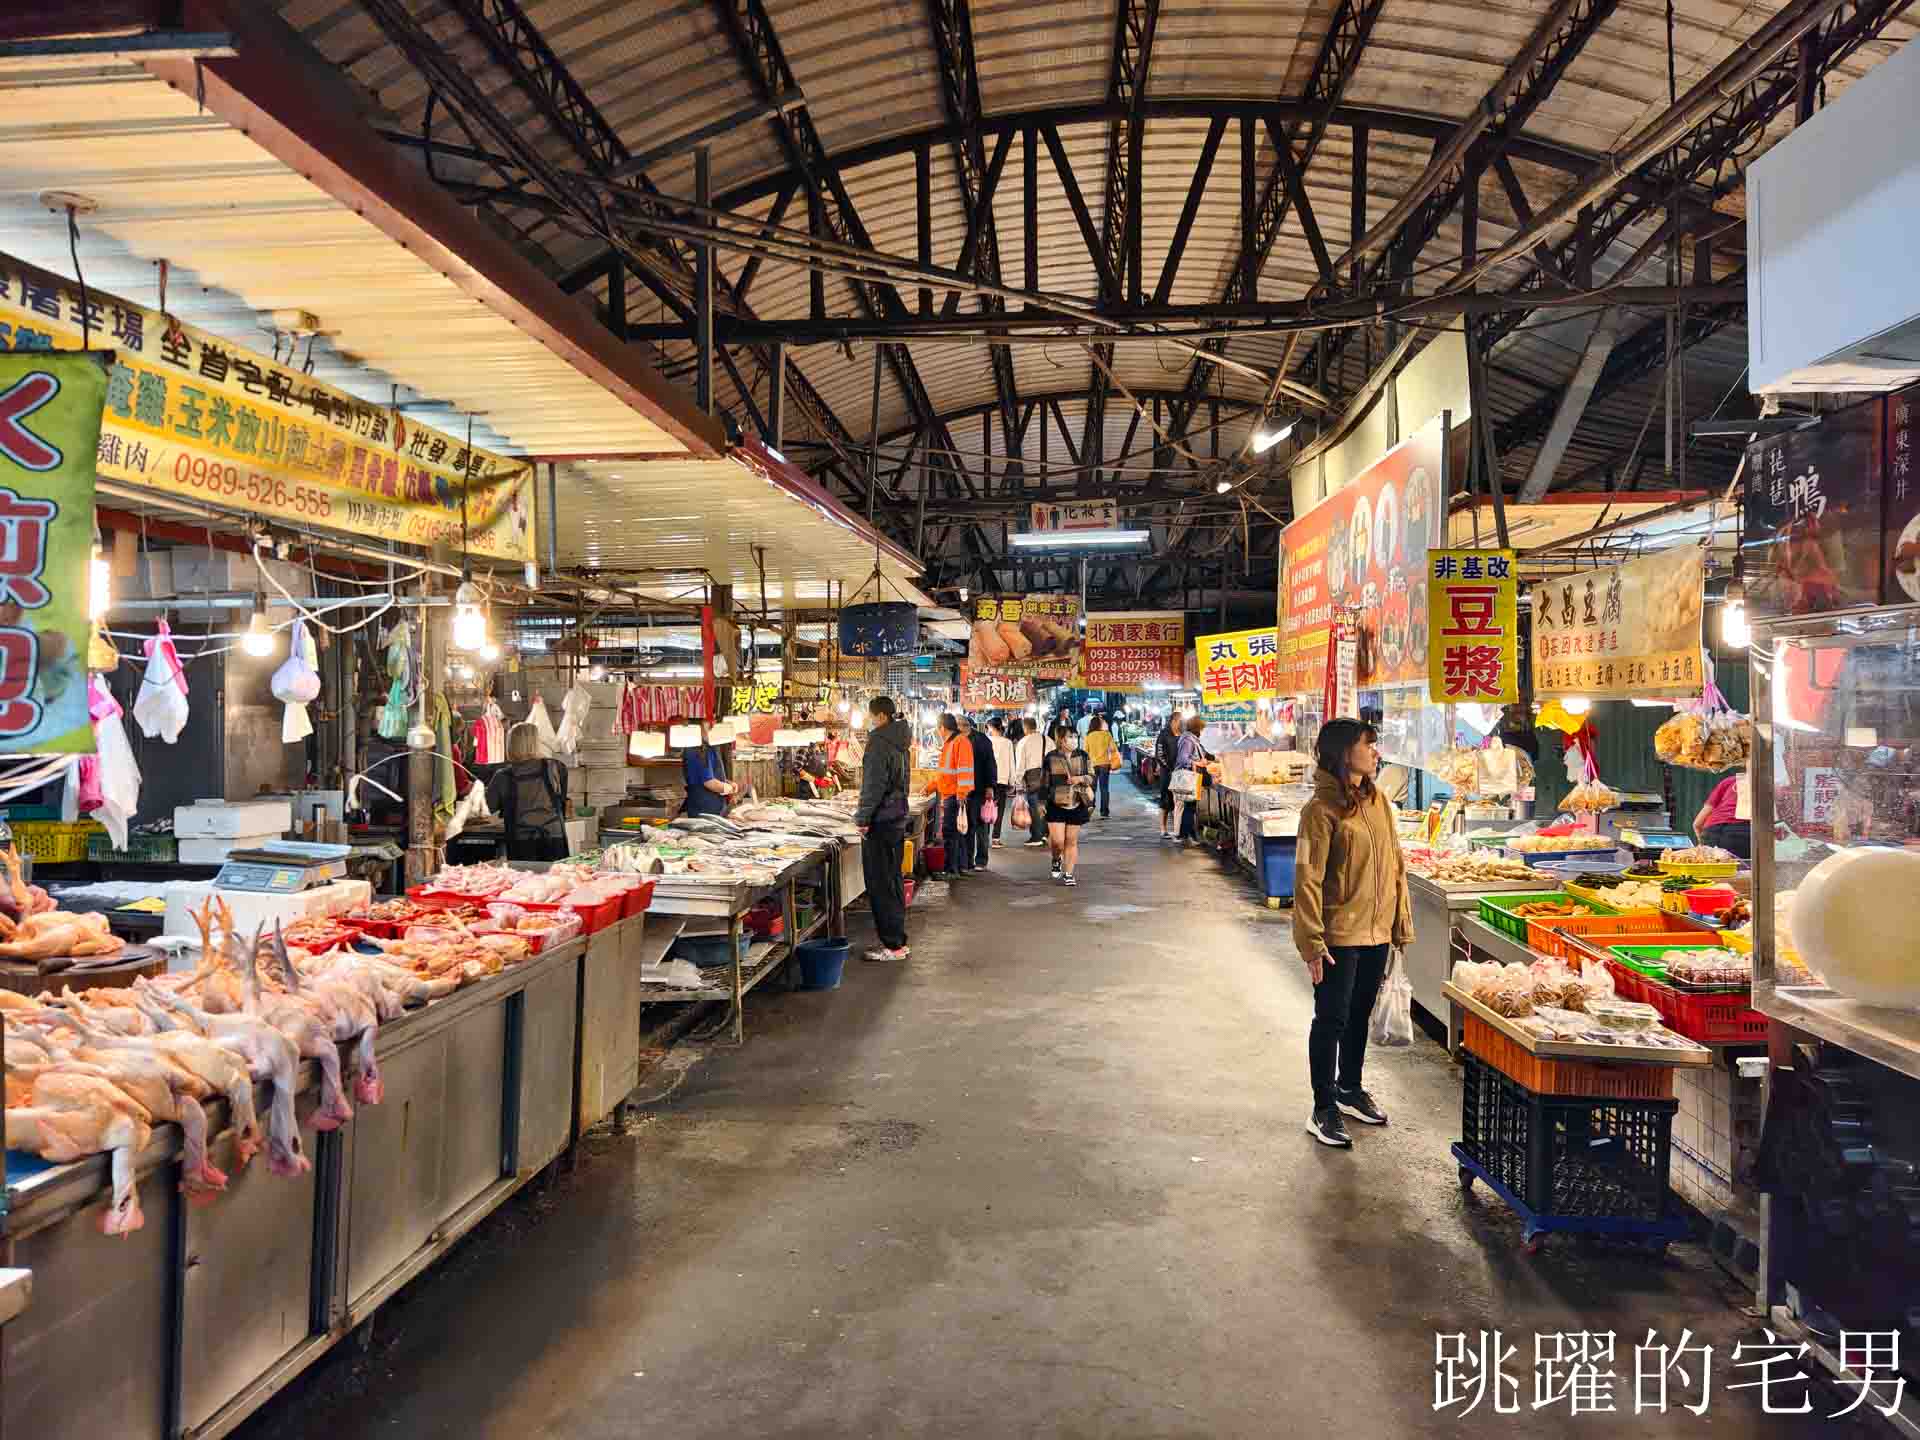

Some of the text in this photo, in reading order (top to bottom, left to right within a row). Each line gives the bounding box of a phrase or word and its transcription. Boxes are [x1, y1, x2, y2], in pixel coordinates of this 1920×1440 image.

[1789, 465, 1828, 527] 鴨
[1434, 556, 1510, 579] 非基改
[1090, 623, 1180, 642] 北濱家禽行
[1441, 584, 1504, 697] 豆漿
[1090, 648, 1161, 660] 0928-122859
[1090, 661, 1161, 673] 0928-007591
